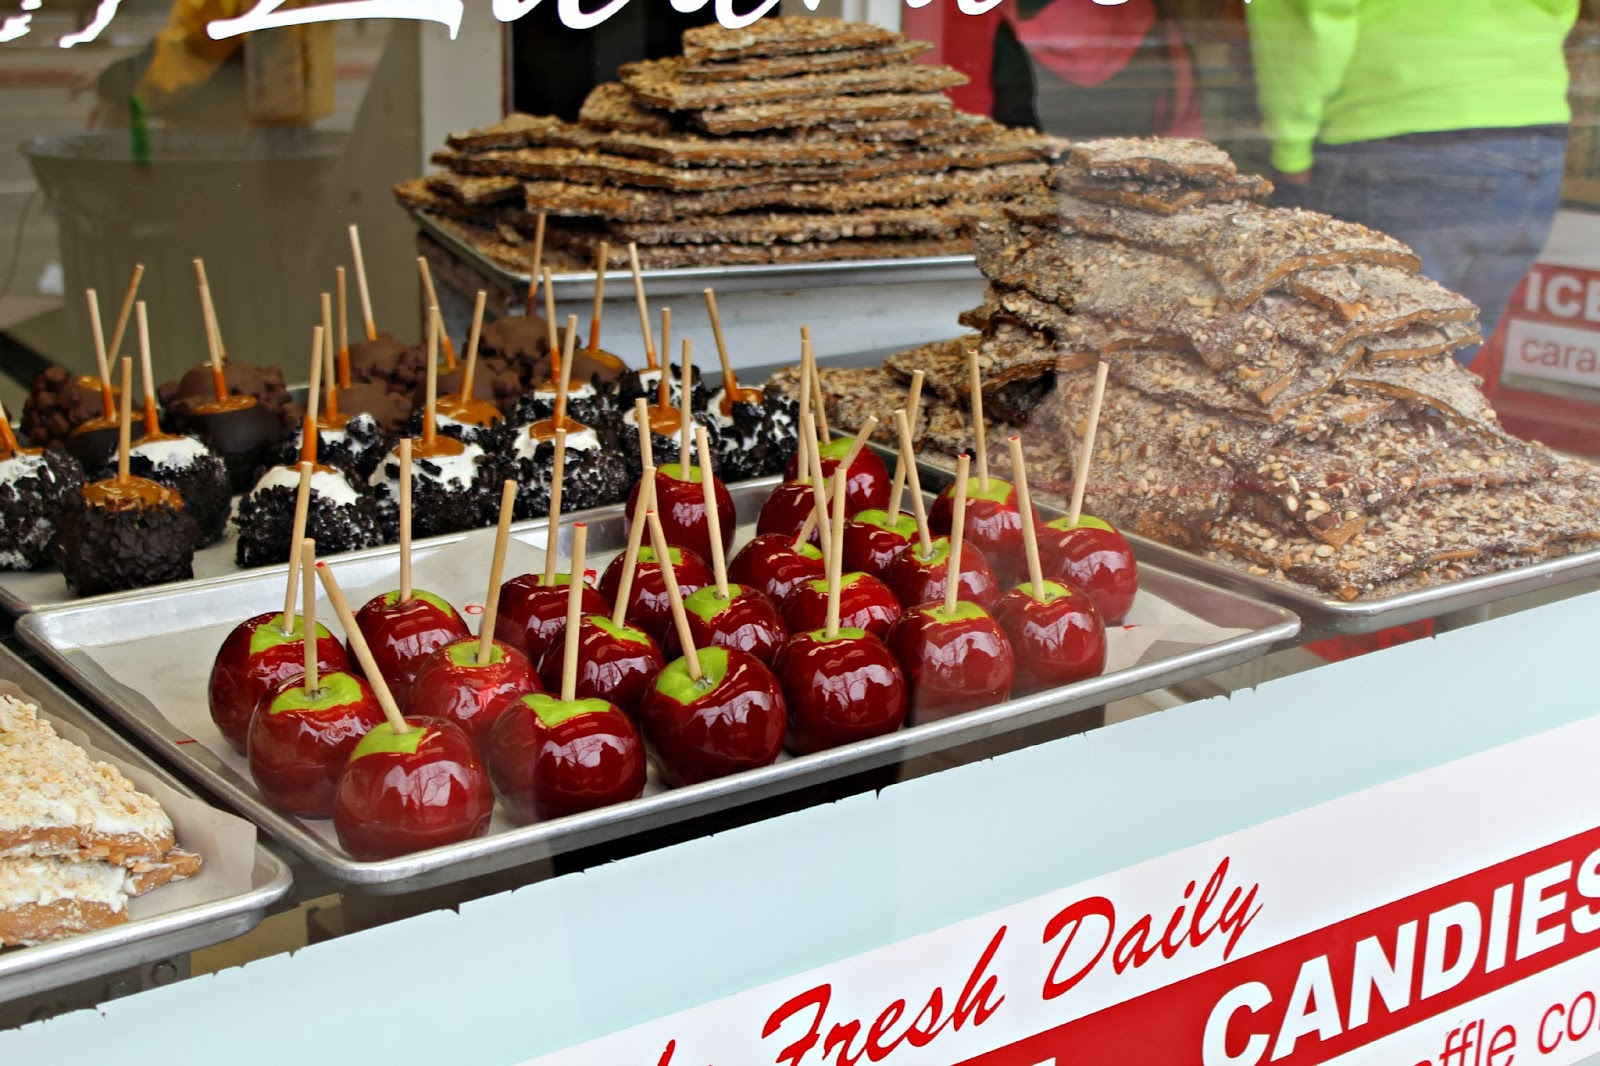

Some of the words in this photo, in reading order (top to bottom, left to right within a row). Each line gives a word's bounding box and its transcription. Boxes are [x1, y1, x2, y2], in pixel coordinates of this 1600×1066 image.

[1521, 338, 1600, 373] cara
[762, 926, 1007, 1066] Fresh
[1042, 856, 1264, 1001] Daily
[1537, 990, 1600, 1055] co
